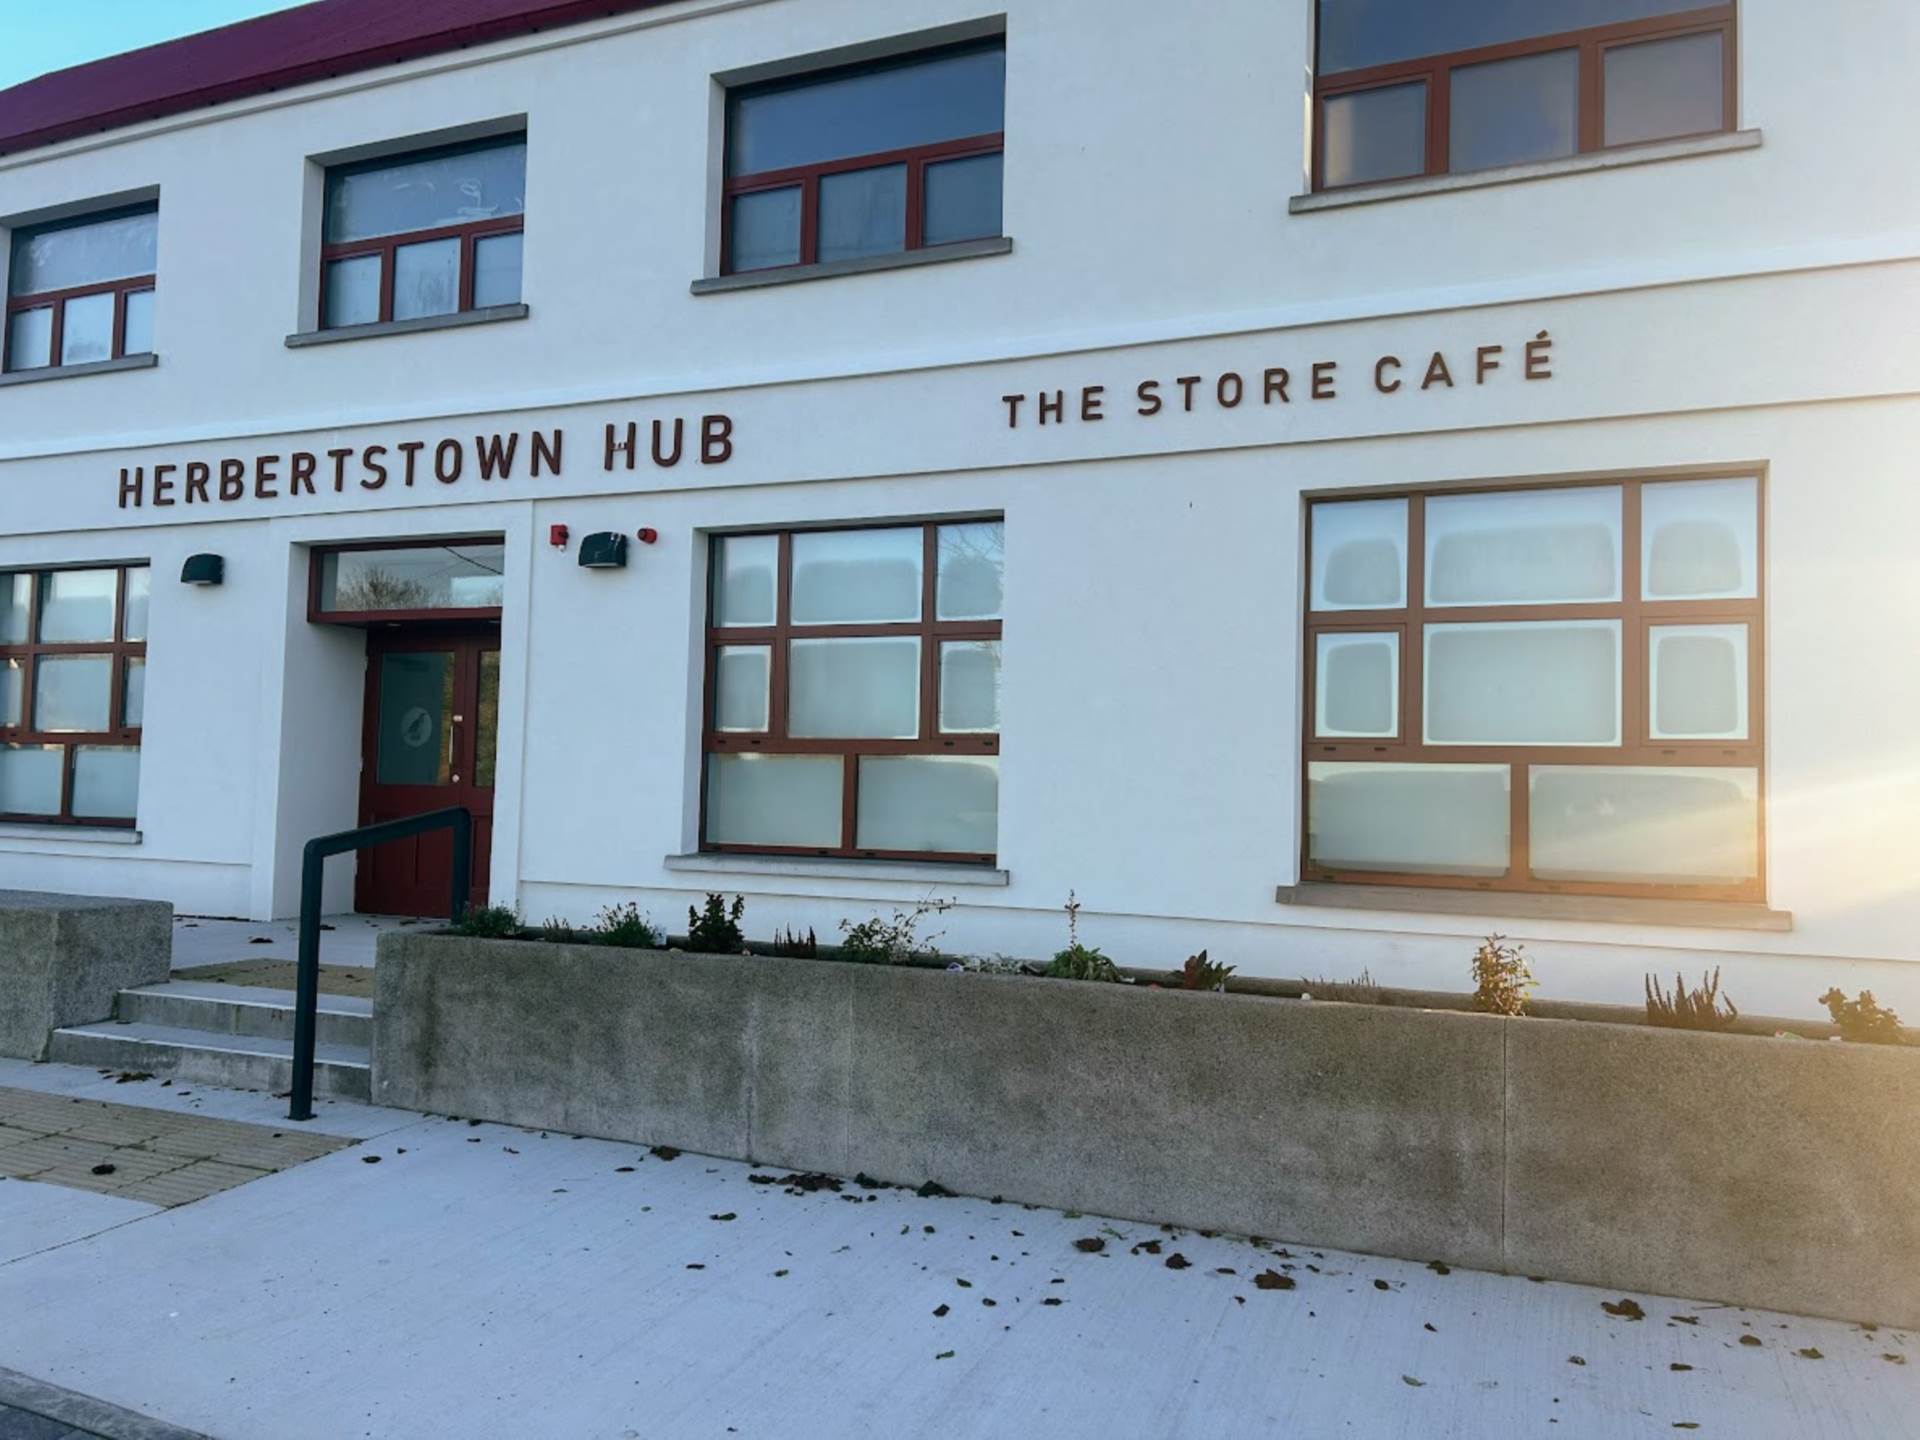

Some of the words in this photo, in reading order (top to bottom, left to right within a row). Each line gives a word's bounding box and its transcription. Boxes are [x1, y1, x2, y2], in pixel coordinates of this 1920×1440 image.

[1001, 385, 1105, 429] THE
[1136, 361, 1337, 417] STORE
[1374, 329, 1553, 394] CAFÉ
[118, 428, 563, 510] HERBERTSTOWN
[603, 414, 734, 472] HUB
